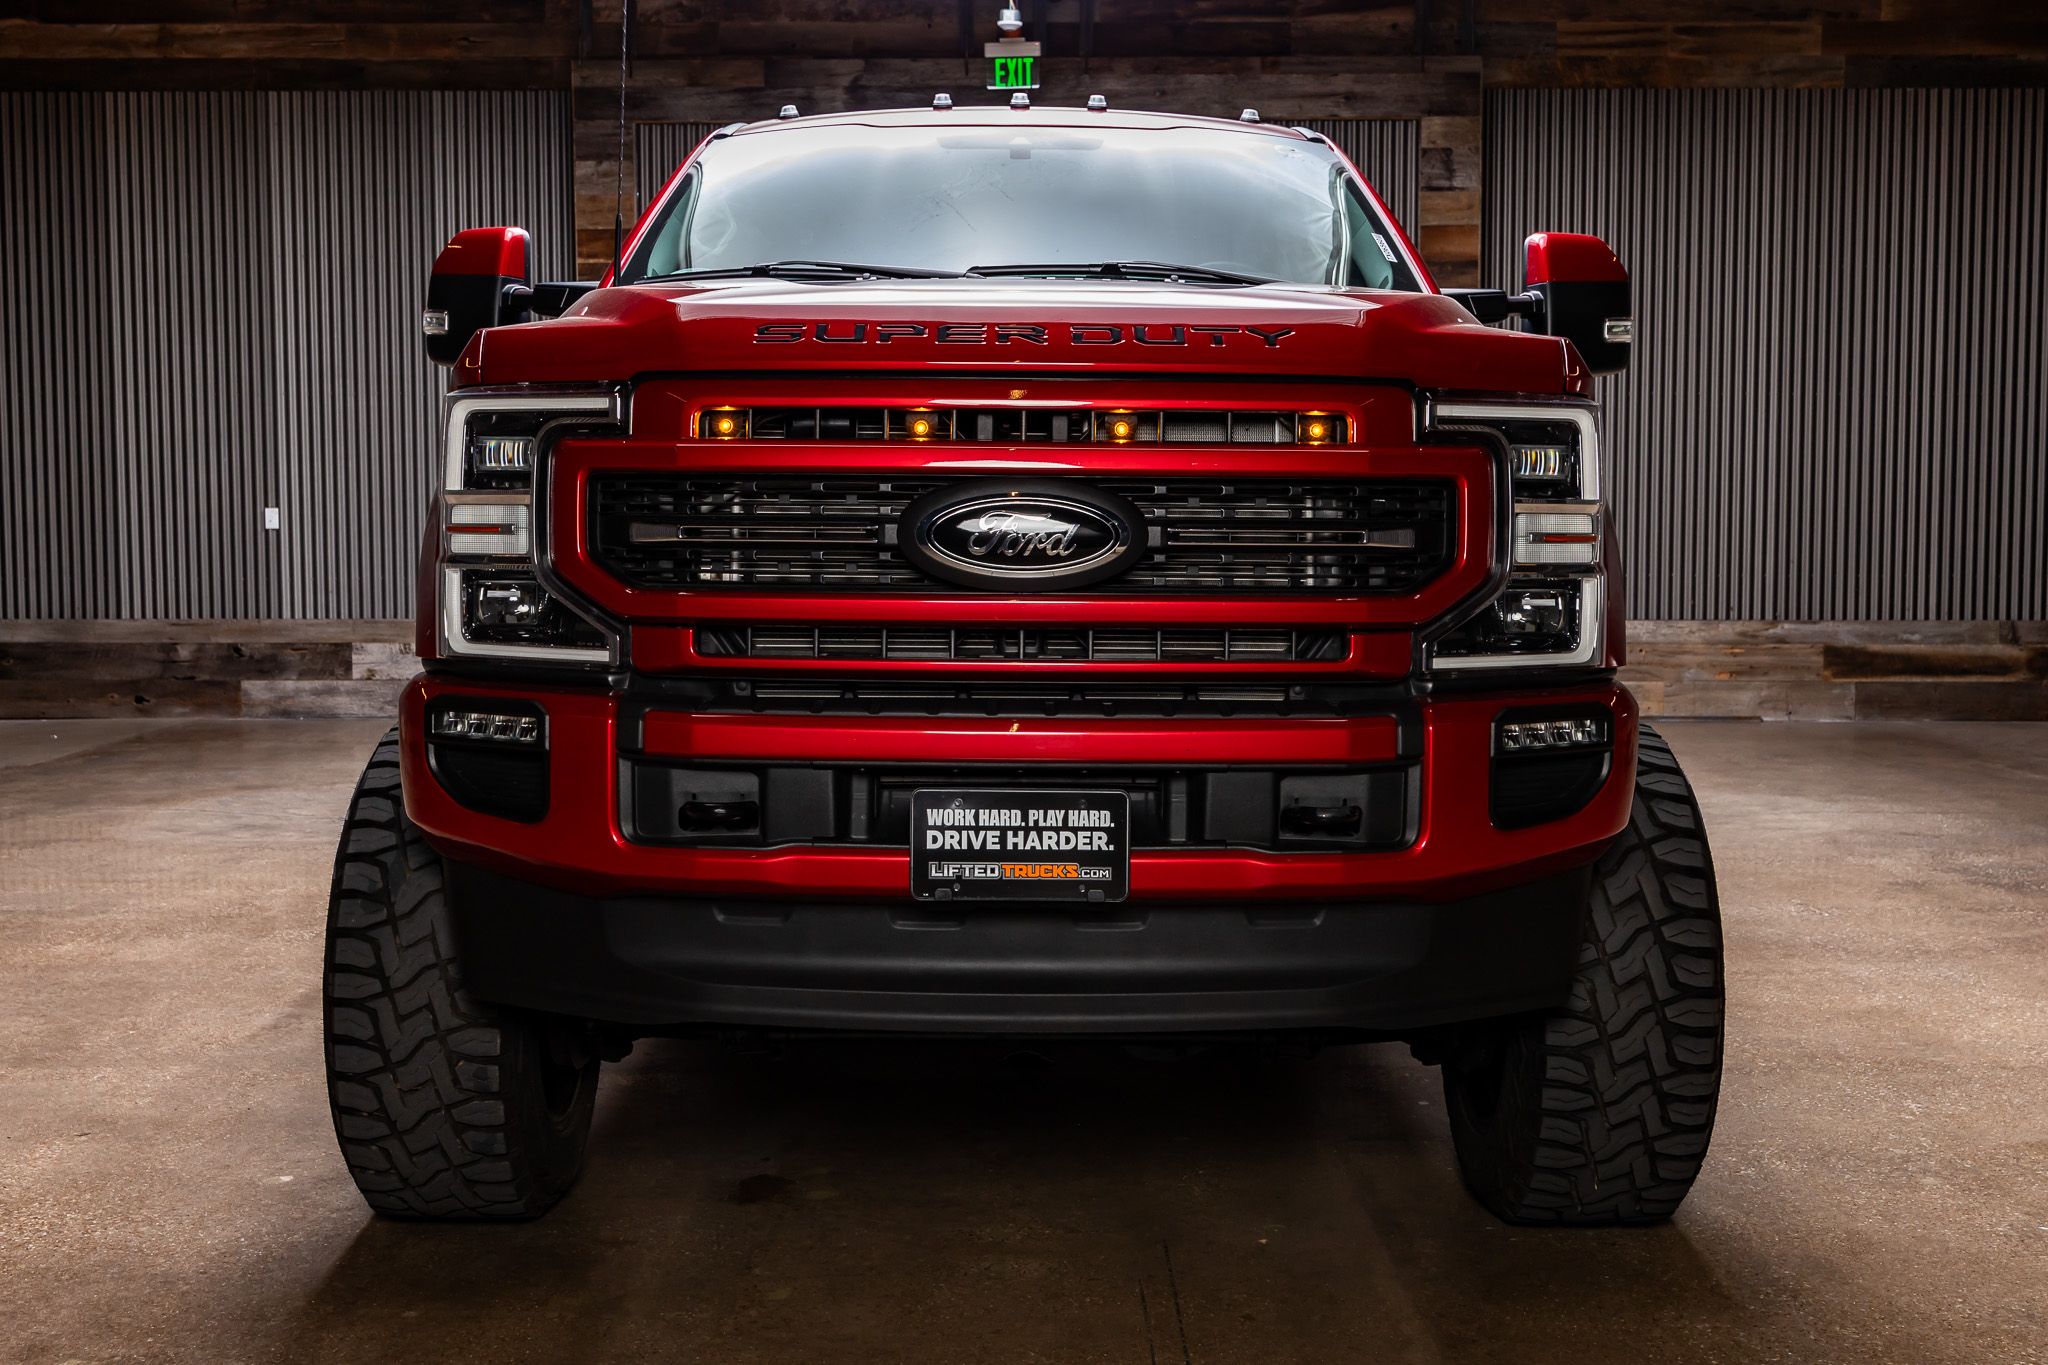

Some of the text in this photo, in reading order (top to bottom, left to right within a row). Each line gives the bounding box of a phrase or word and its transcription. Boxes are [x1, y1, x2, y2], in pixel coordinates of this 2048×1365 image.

[995, 58, 1033, 87] EXIT
[753, 324, 1296, 348] SUPER DUTY
[968, 510, 1080, 556] Ford
[926, 809, 1114, 827] WORK HARD. PLAY HARD.
[926, 830, 1114, 850] DRIVE HARDER.
